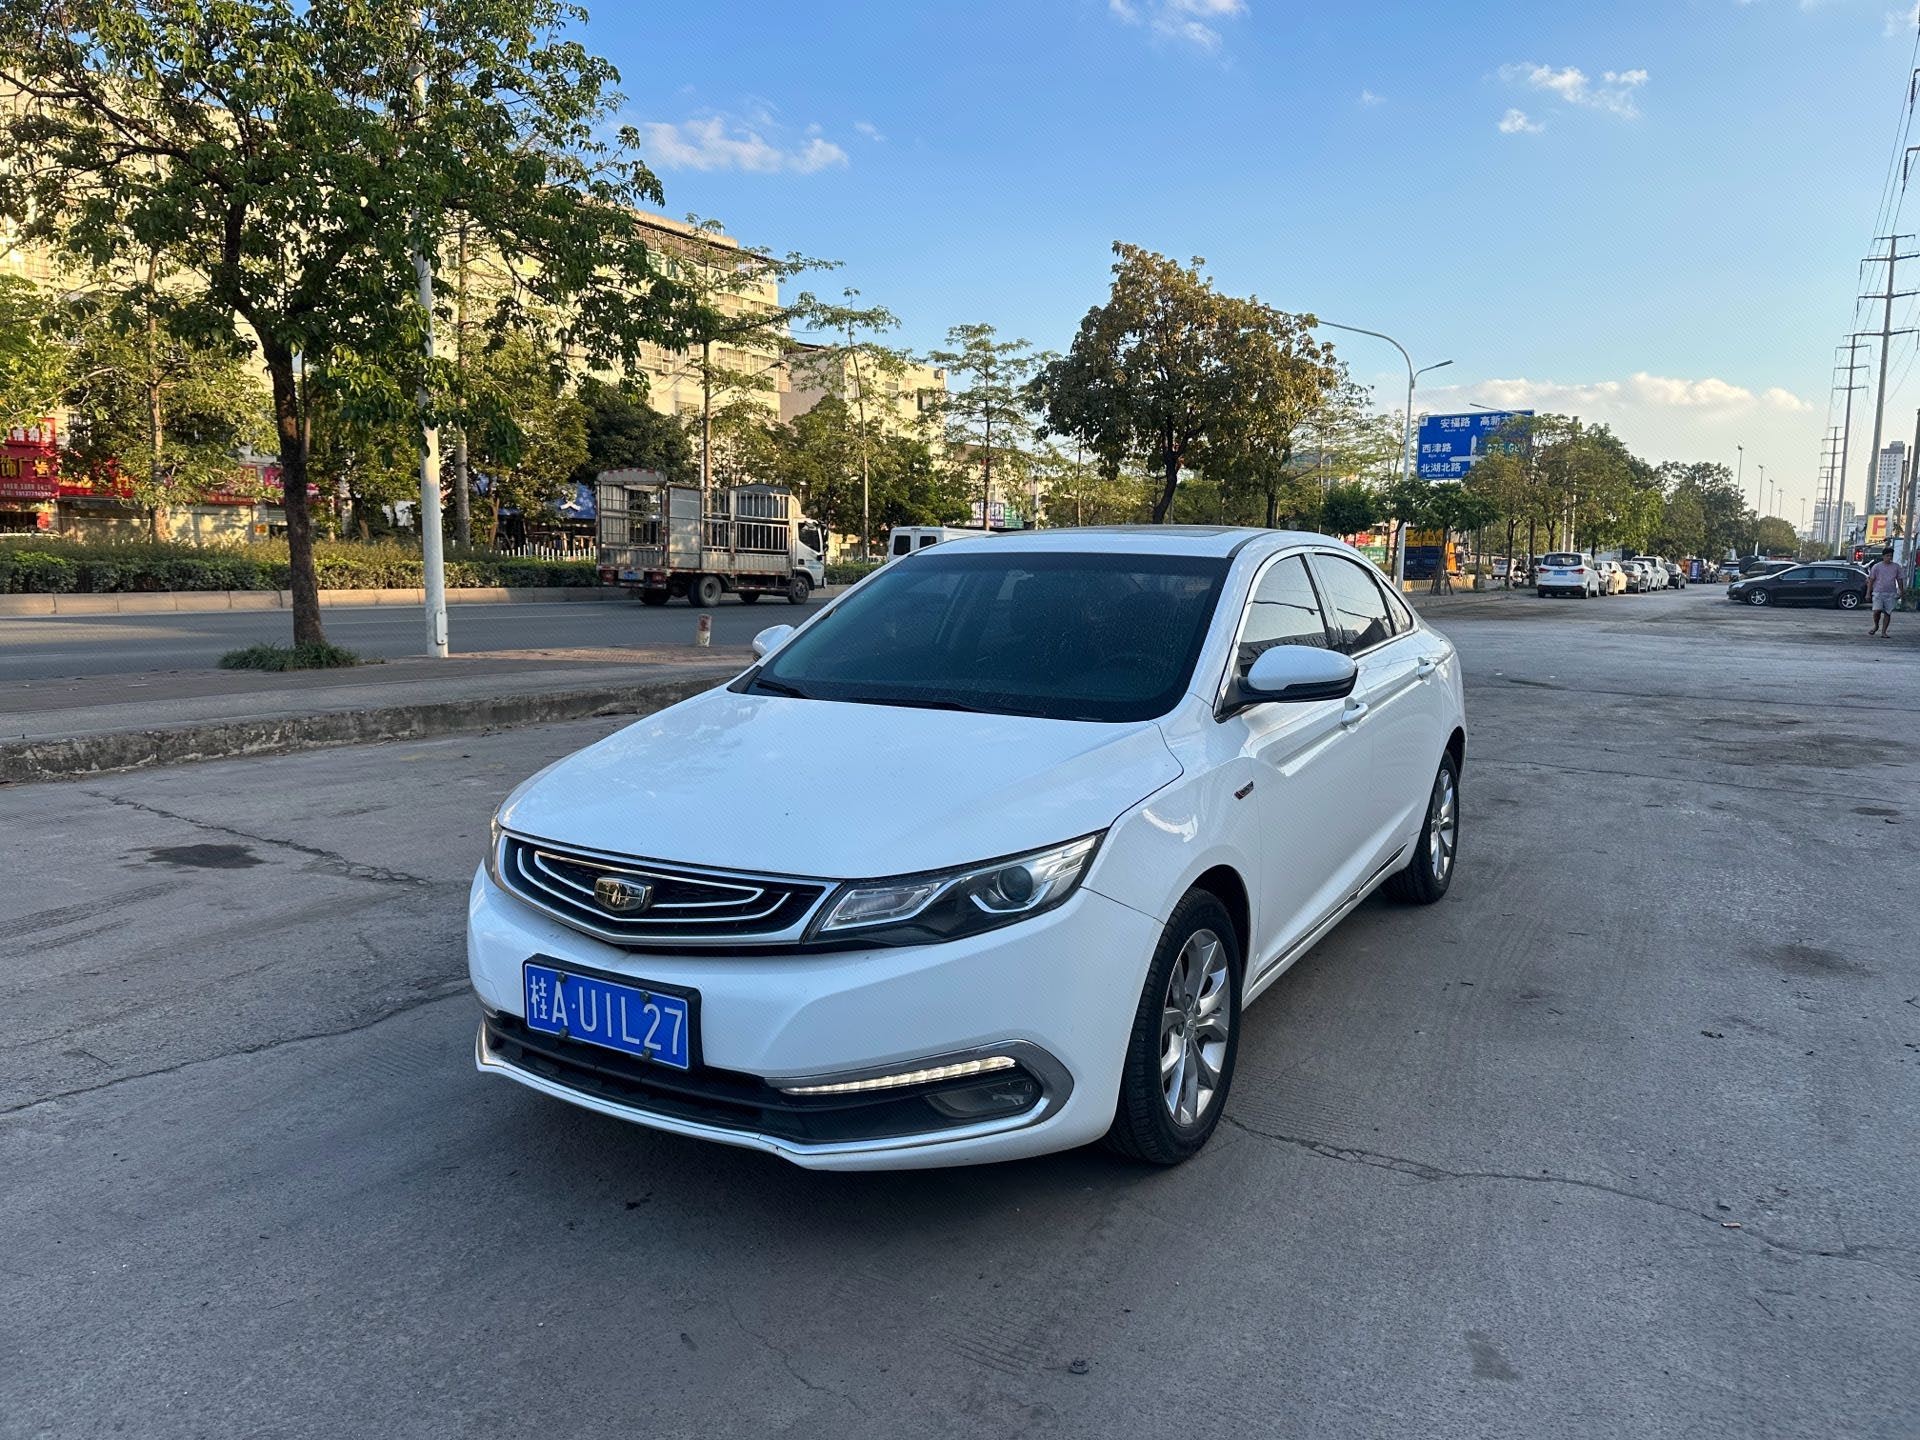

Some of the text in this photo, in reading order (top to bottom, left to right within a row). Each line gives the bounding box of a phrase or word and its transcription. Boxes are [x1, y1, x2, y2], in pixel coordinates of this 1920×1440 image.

[1440, 417, 1471, 428] 安福路
[1422, 443, 1452, 453] 西津路
[1421, 462, 1461, 473] 北湖北路
